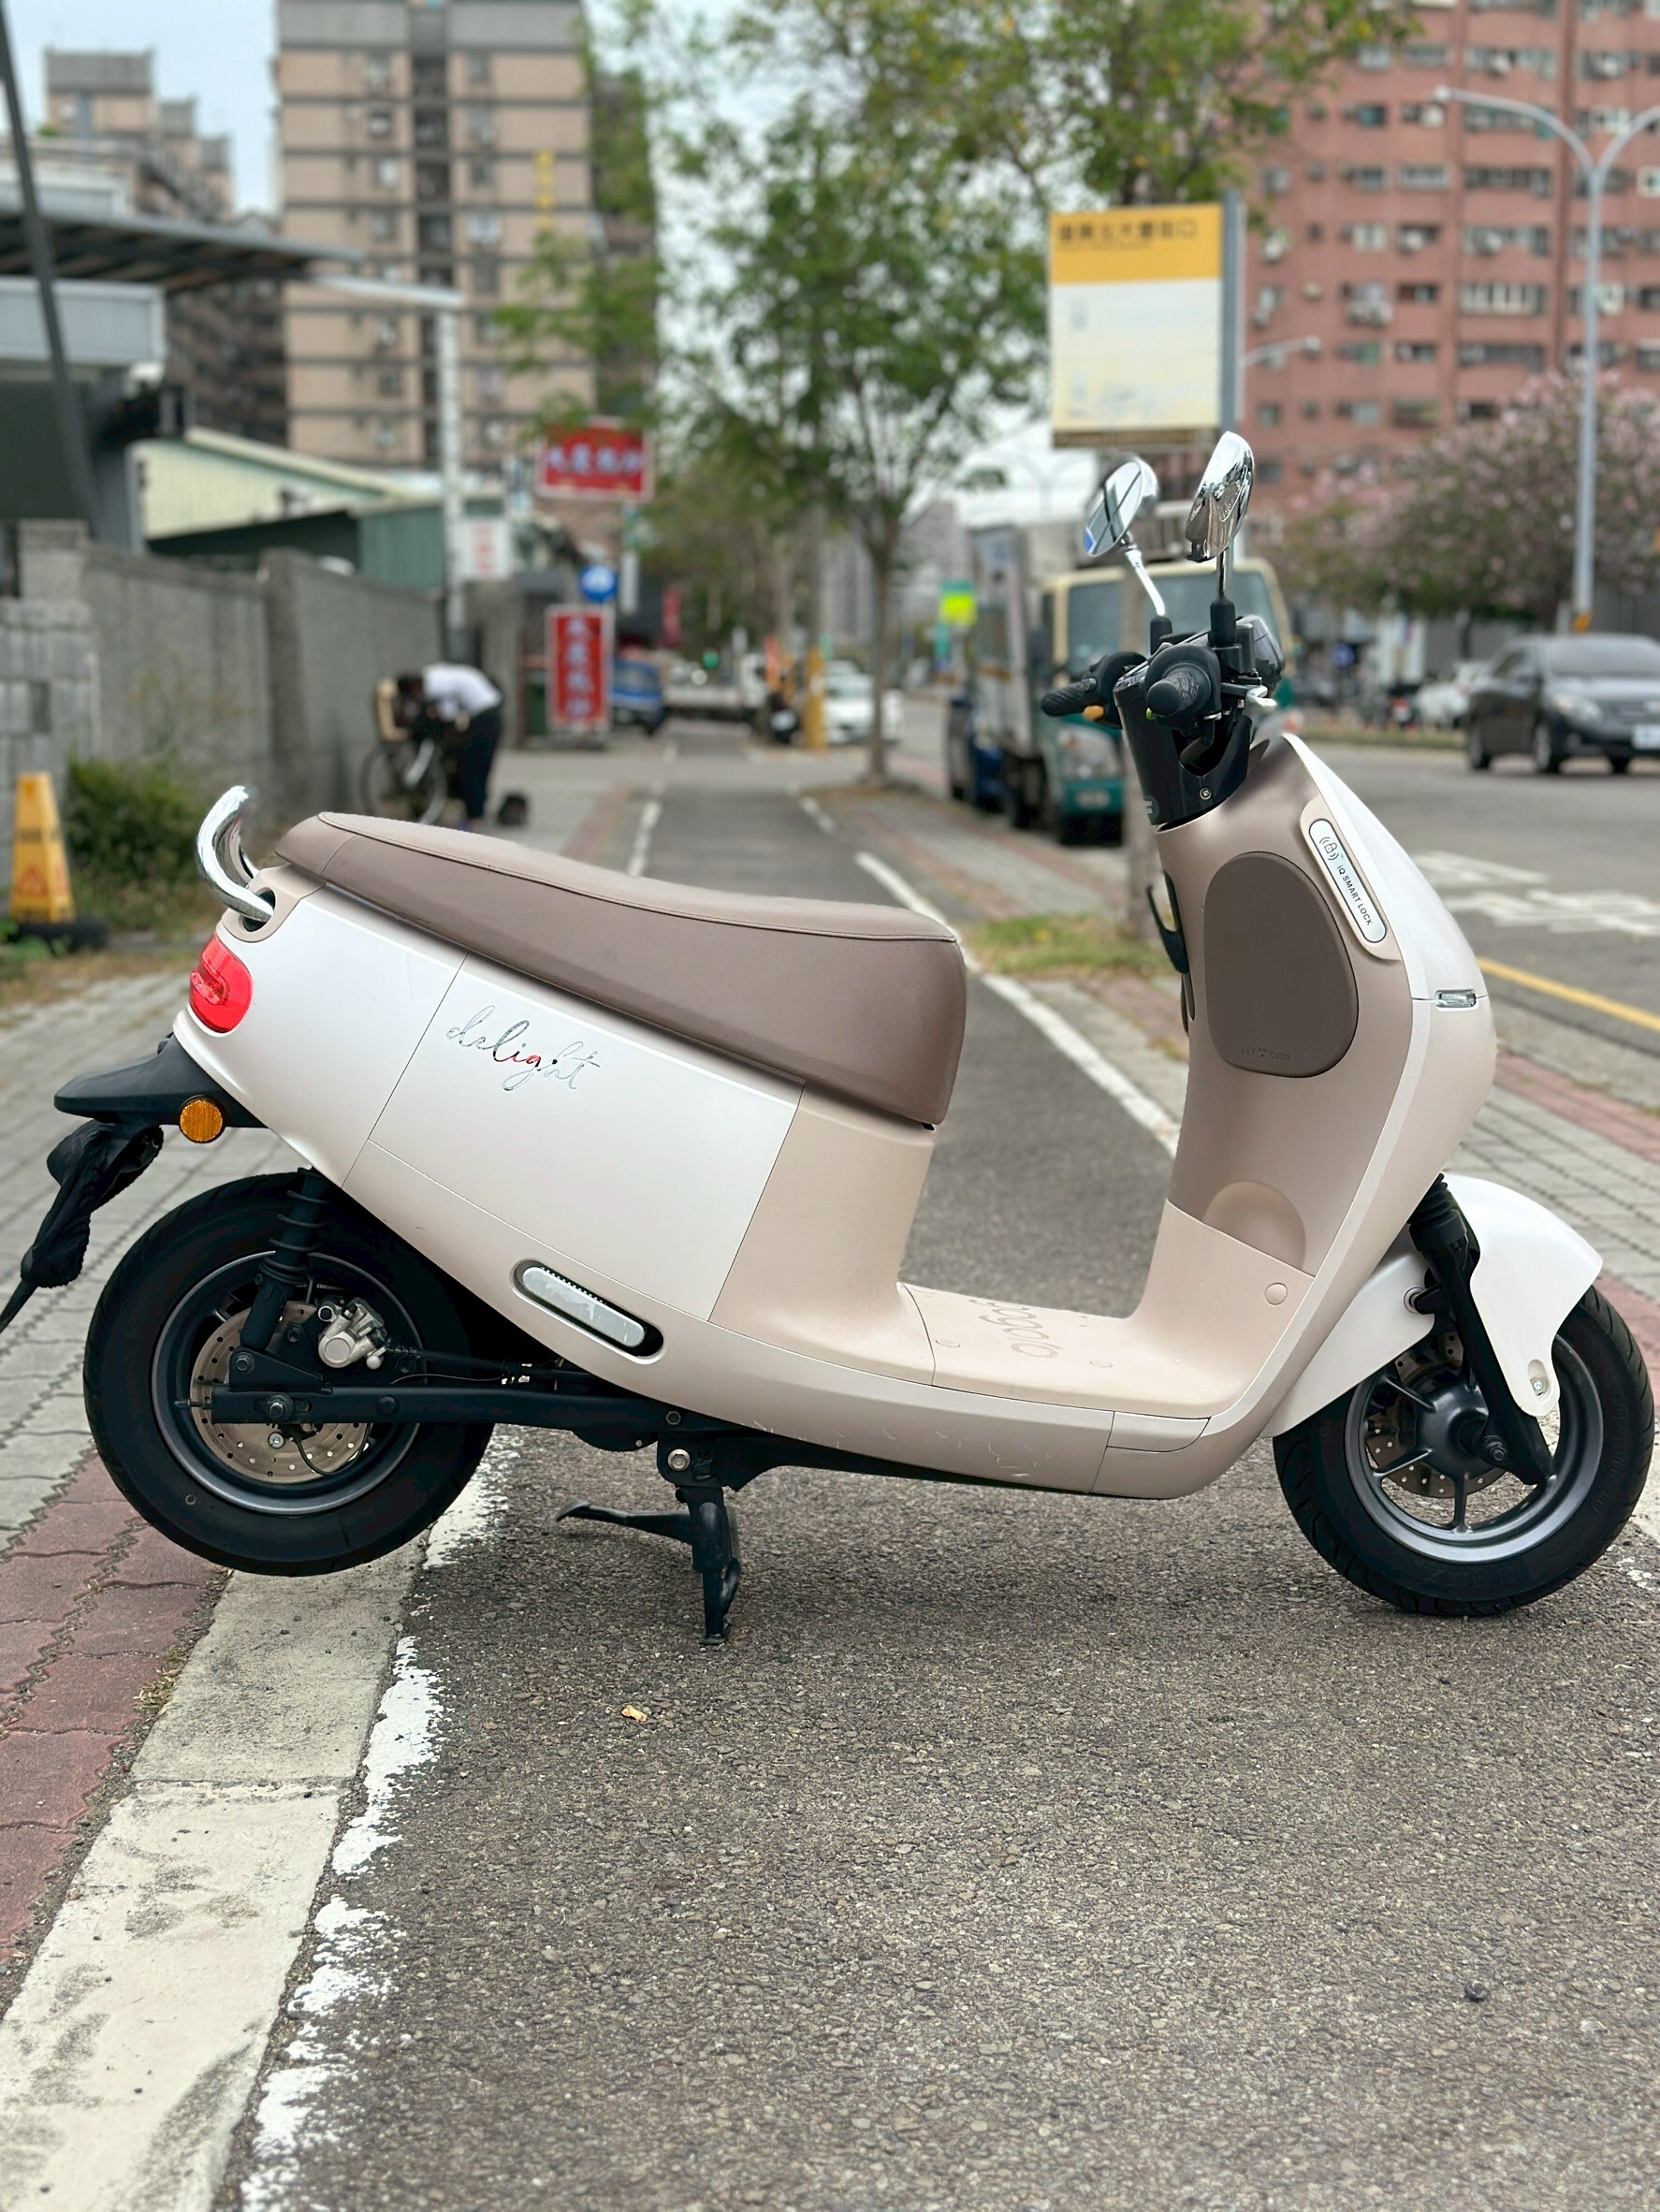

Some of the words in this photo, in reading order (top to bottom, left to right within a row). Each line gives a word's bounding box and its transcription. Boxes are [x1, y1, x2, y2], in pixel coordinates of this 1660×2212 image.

[1343, 875, 1361, 901] SMART
[1358, 903, 1373, 925] LOCK
[445, 1005, 601, 1091] delight
